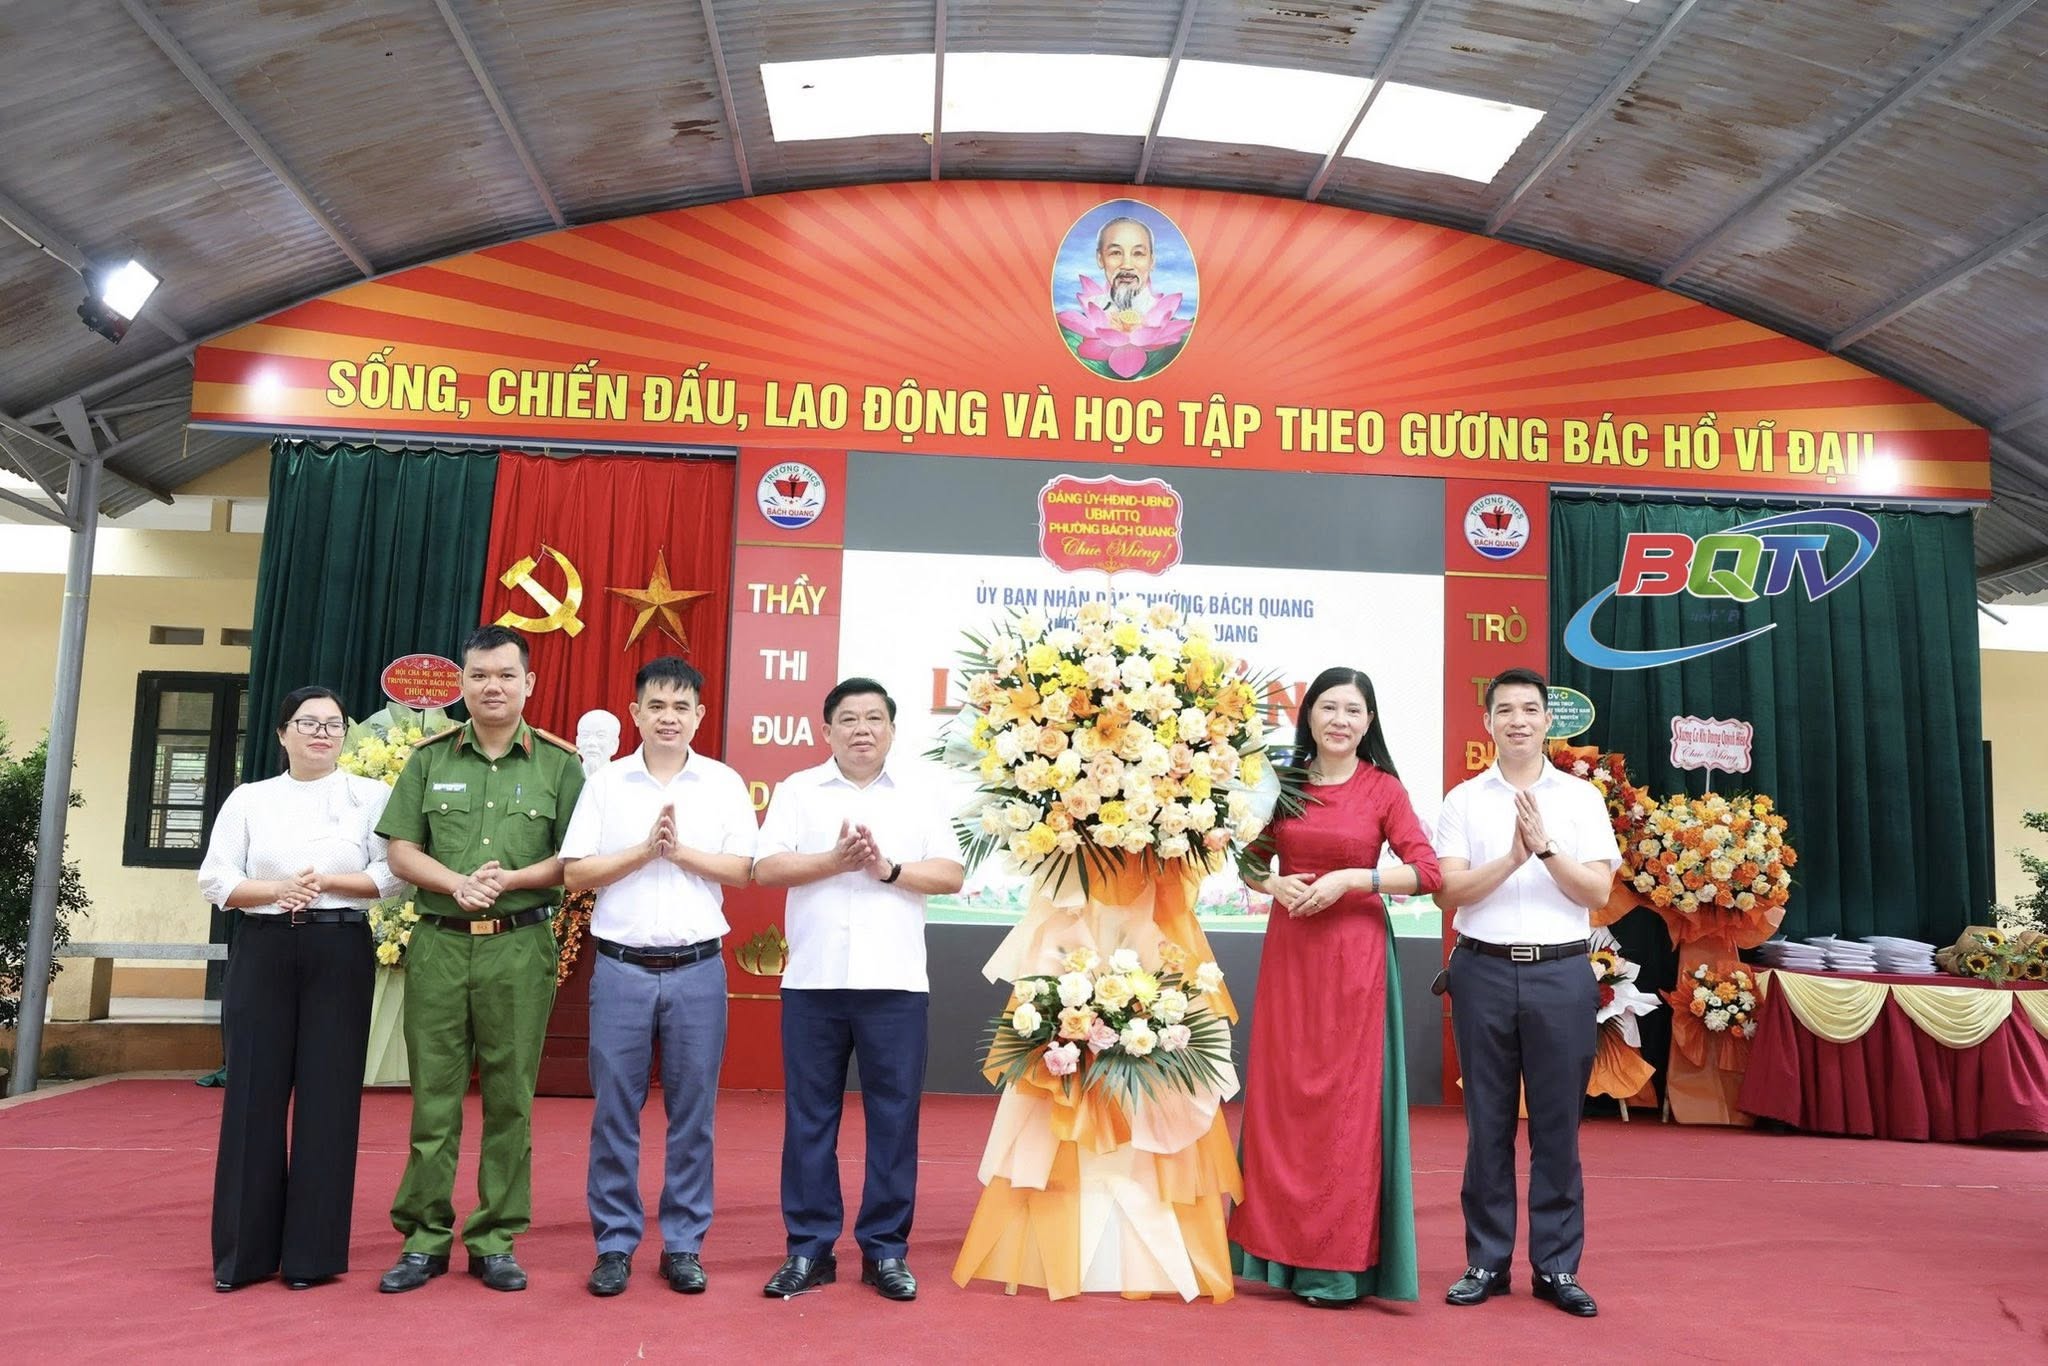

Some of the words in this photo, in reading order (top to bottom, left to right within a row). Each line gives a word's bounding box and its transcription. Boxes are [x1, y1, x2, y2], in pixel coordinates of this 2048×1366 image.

[326, 346, 472, 420] SỐNG,
[487, 359, 628, 421] CHIẾN
[642, 362, 749, 431] ĐẤU,
[764, 380, 849, 430] LAO
[862, 378, 988, 443] ĐỘNG
[1001, 385, 1061, 440] VÀ
[1073, 395, 1164, 453] HỌC
[1178, 392, 1262, 458] TẬP
[1275, 406, 1385, 456] THEO
[1400, 411, 1549, 463] GƯƠNG
[1564, 412, 1651, 468] BÁC
[1663, 411, 1722, 471] HỒ
[1732, 419, 1777, 473] VĨ
[802, 467, 821, 488] THCS
[1047, 490, 1082, 504] ĐẢNG
[788, 509, 815, 518] QUANG
[1085, 507, 1140, 523] UBMTTQ
[1506, 499, 1525, 520] THCS
[1049, 521, 1100, 535] PHƯỜNG
[1102, 521, 1134, 536] BÁCH
[1136, 525, 1176, 538] QUANG
[1061, 536, 1101, 557] Chúc
[1495, 540, 1520, 549] QUANG
[748, 574, 827, 615] THẦY
[976, 579, 998, 605] ỦY
[1003, 587, 1037, 606] BAN
[1044, 586, 1090, 608] NHÂN
[1209, 592, 1252, 616] BÁCH
[1259, 598, 1314, 619] QUANG
[1466, 606, 1528, 643] TRÒ
[433, 671, 444, 679] HỌC
[760, 649, 808, 681] THI
[404, 685, 424, 696] CHÚC
[430, 678, 445, 686] BÁCH
[751, 715, 814, 746] ĐUA
